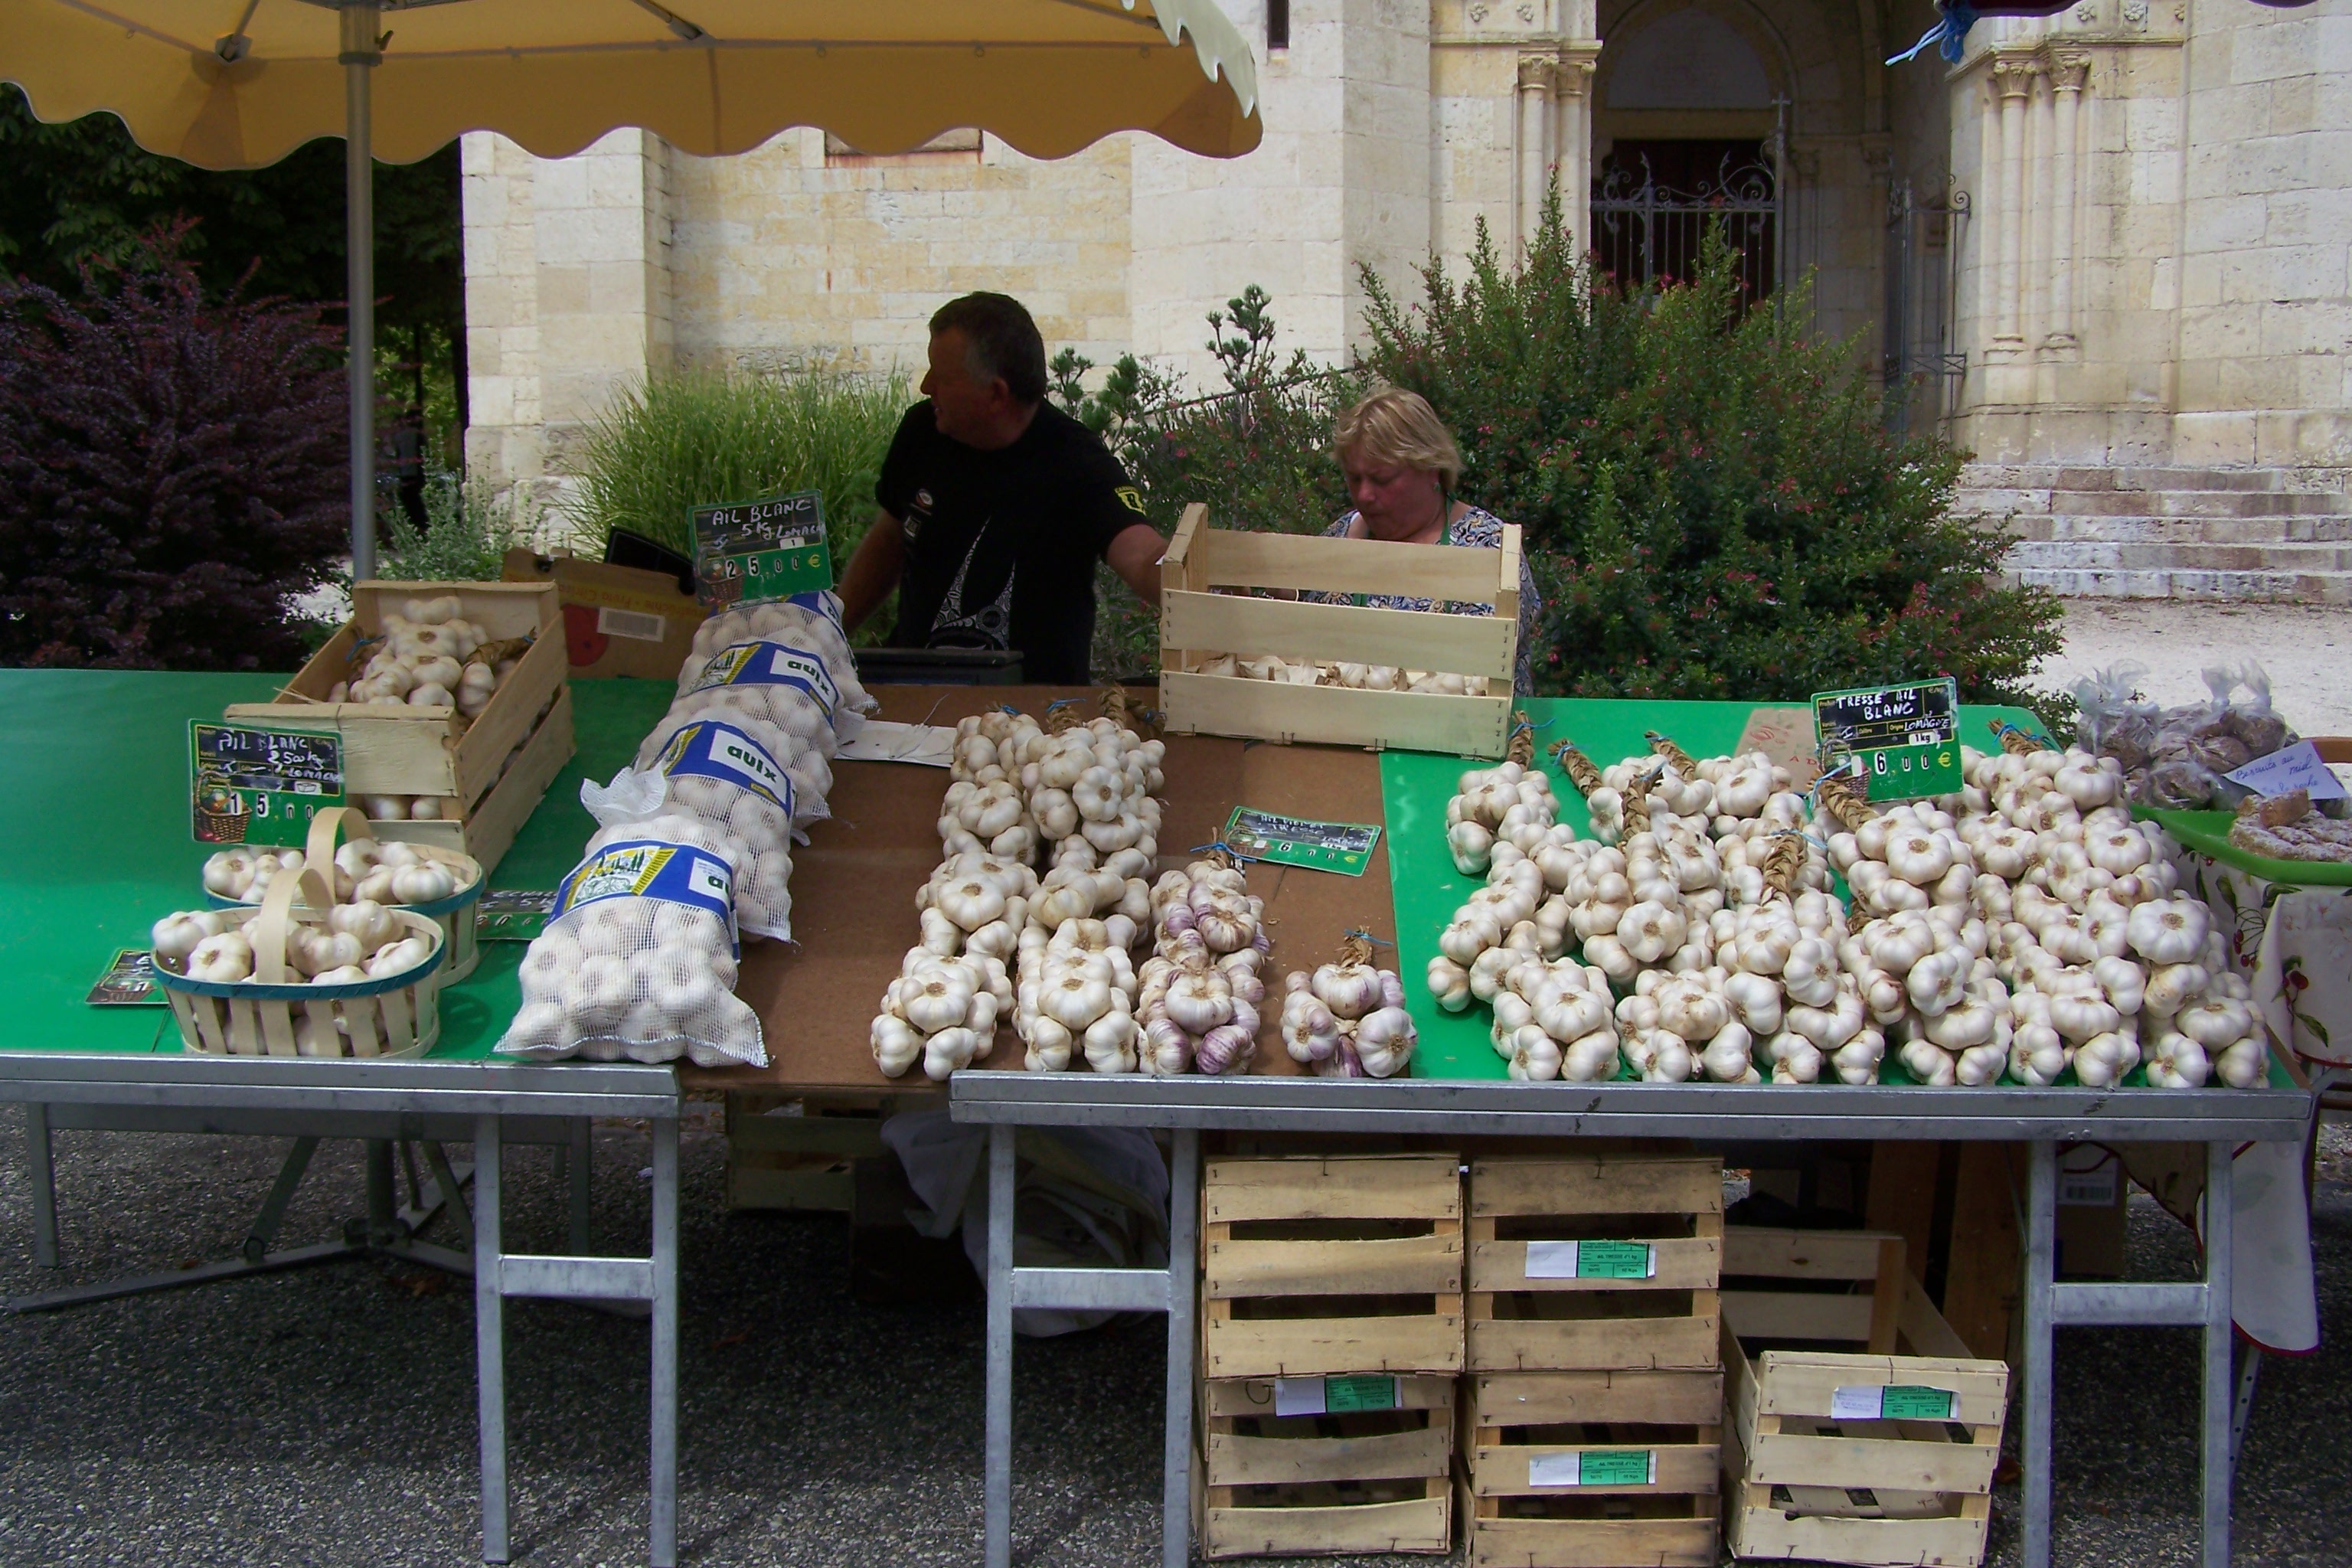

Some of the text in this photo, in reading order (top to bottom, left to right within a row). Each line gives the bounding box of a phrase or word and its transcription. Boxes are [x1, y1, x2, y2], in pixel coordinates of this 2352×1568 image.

[750, 498, 812, 523] BLANC
[1836, 694, 1883, 709] TRESSE
[1864, 702, 1914, 720] BLANC
